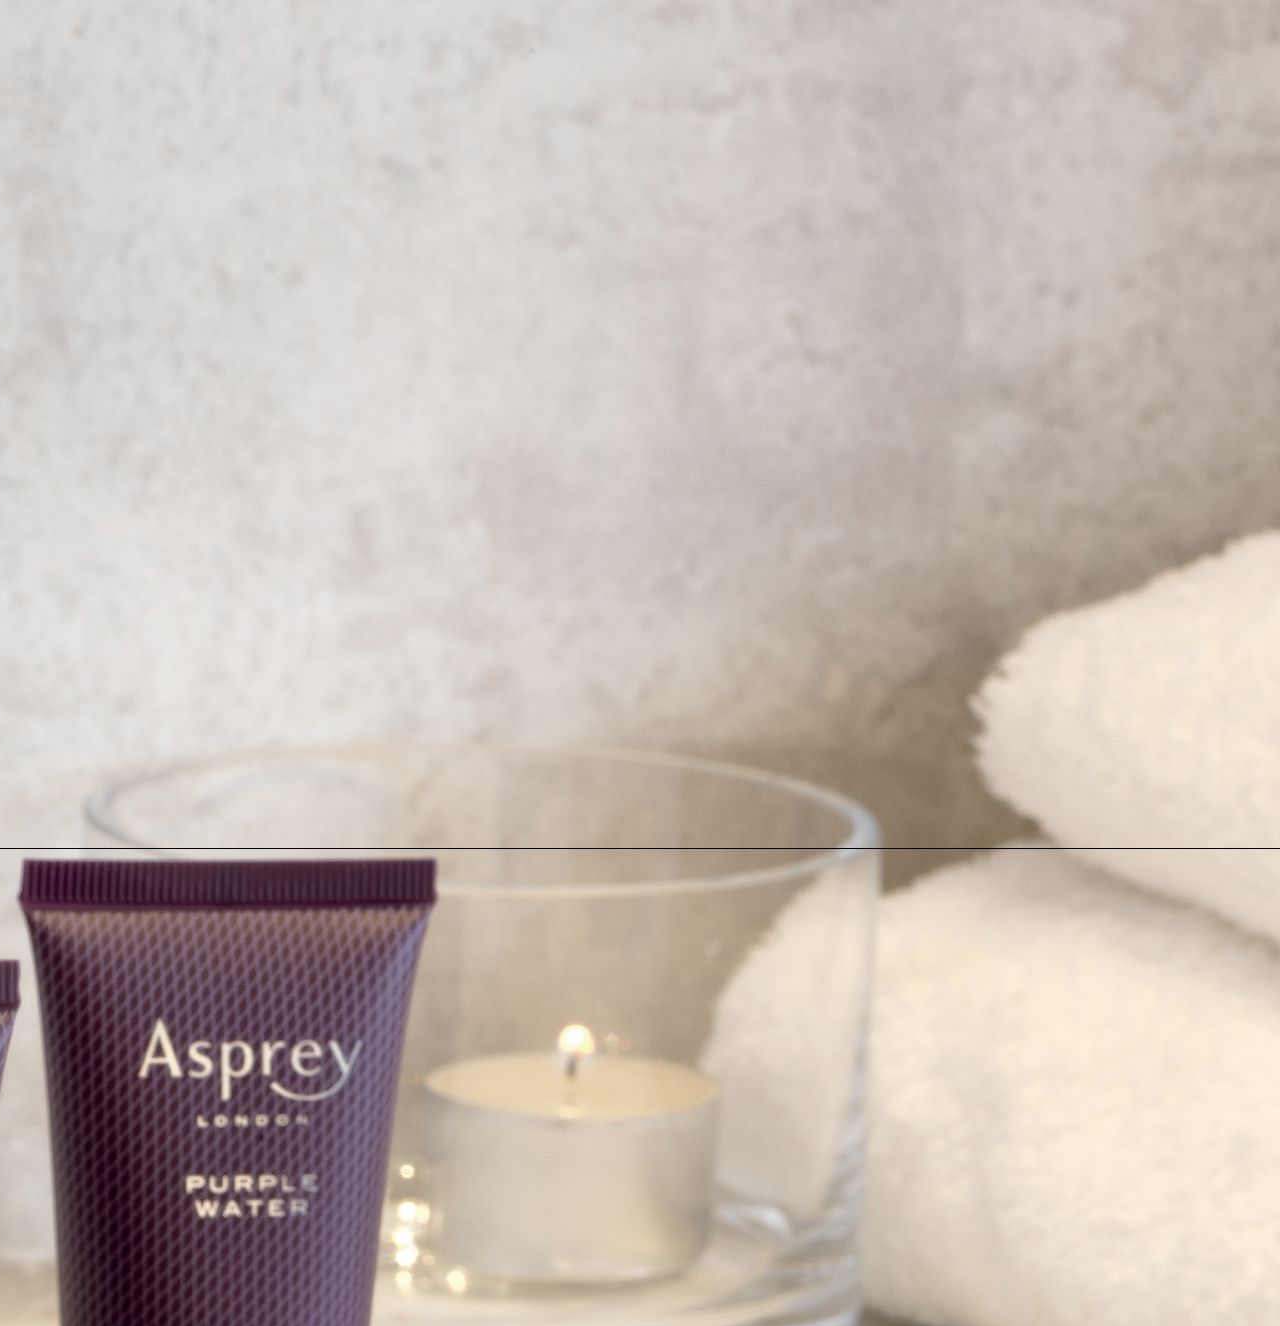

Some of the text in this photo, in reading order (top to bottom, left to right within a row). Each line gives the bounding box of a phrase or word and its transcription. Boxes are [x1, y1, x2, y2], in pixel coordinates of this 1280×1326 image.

[138, 1017, 364, 1101] Asprey
[197, 1113, 310, 1128] LONDON
[185, 1173, 319, 1194] PURPLE
[195, 1199, 310, 1219] WATER
